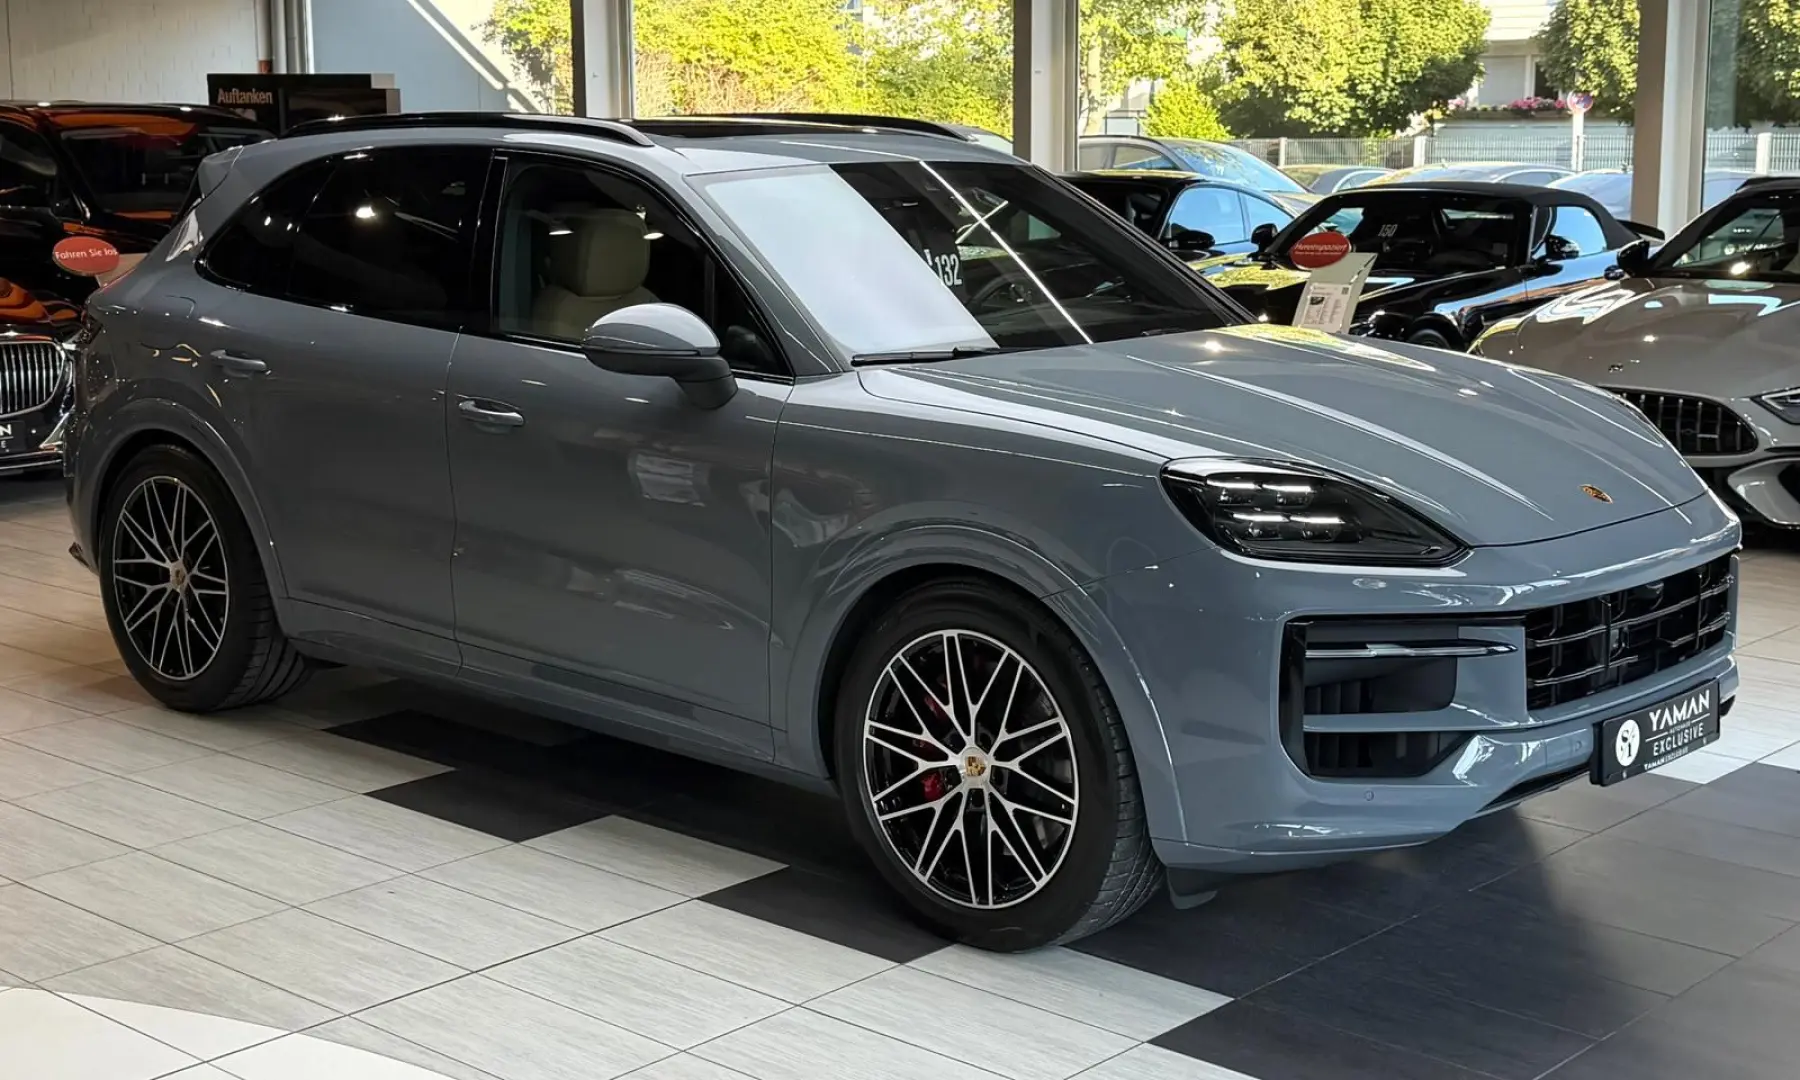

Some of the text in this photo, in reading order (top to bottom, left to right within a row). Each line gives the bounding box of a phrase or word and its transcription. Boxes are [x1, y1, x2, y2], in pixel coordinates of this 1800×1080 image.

[218, 88, 272, 104] Auftanken
[1378, 224, 1398, 237] 150
[55, 251, 87, 259] Fahren
[1649, 690, 1709, 731] YAMAN
[1653, 721, 1704, 757] EXCLUSIVE
